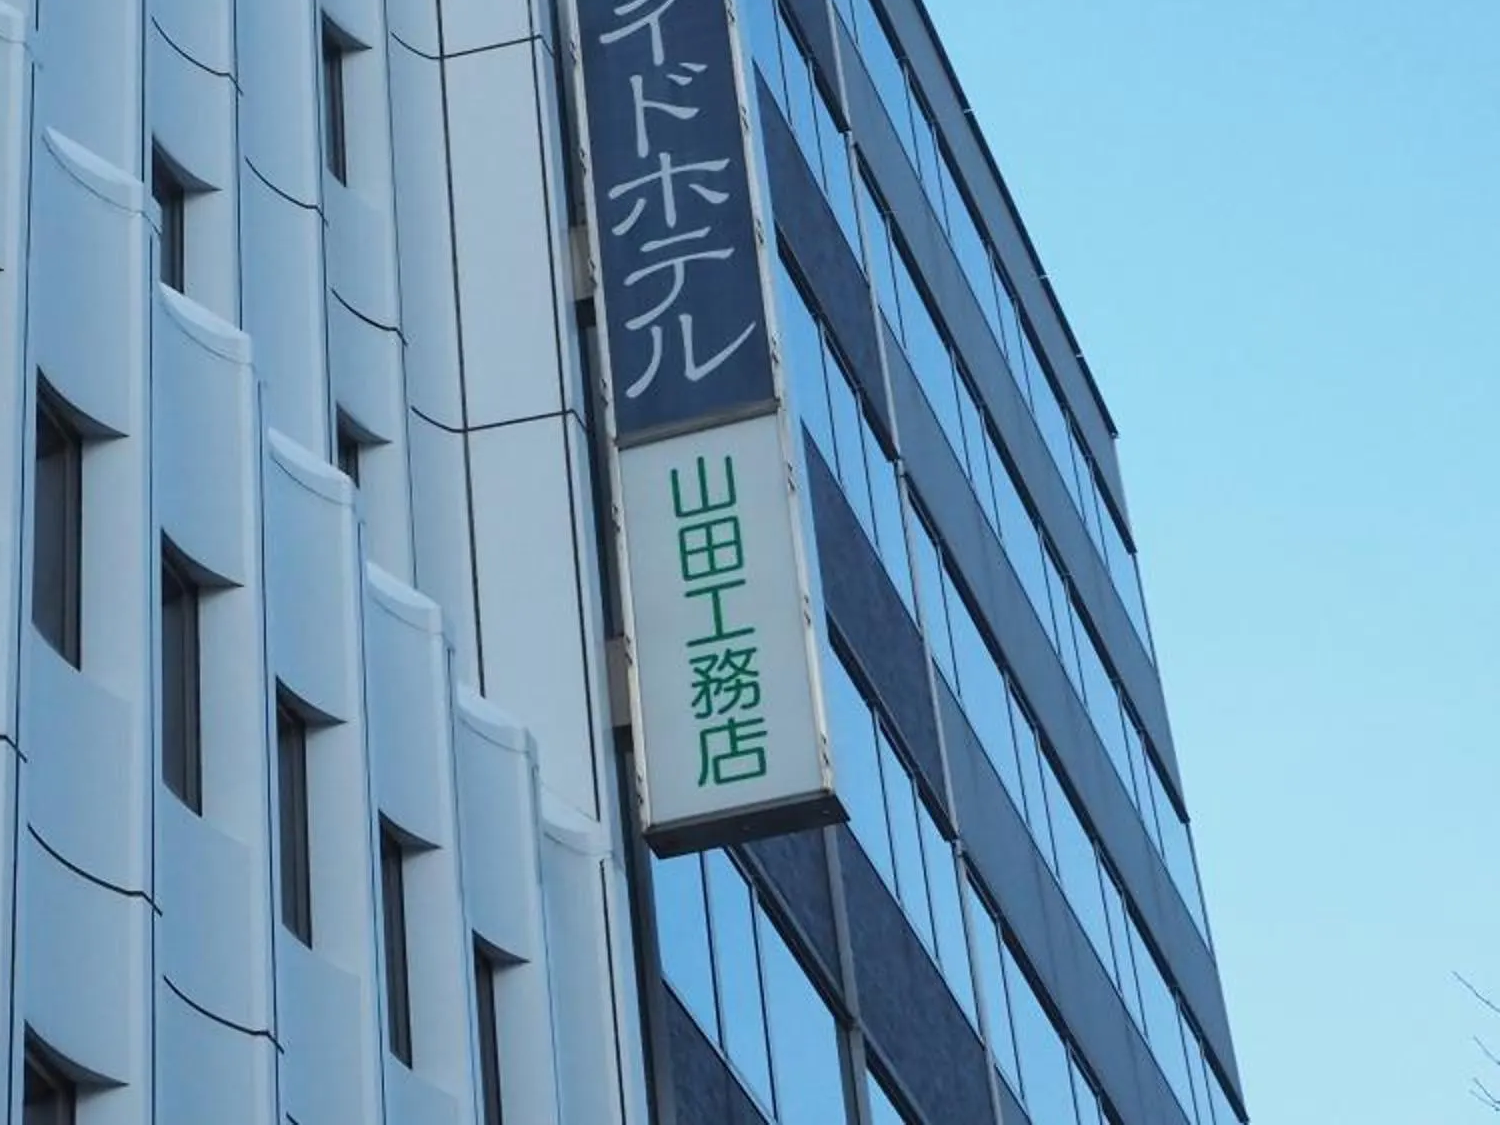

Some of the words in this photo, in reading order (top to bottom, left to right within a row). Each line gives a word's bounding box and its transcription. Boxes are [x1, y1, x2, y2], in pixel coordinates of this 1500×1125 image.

[670, 454, 769, 788] 山田工務店
